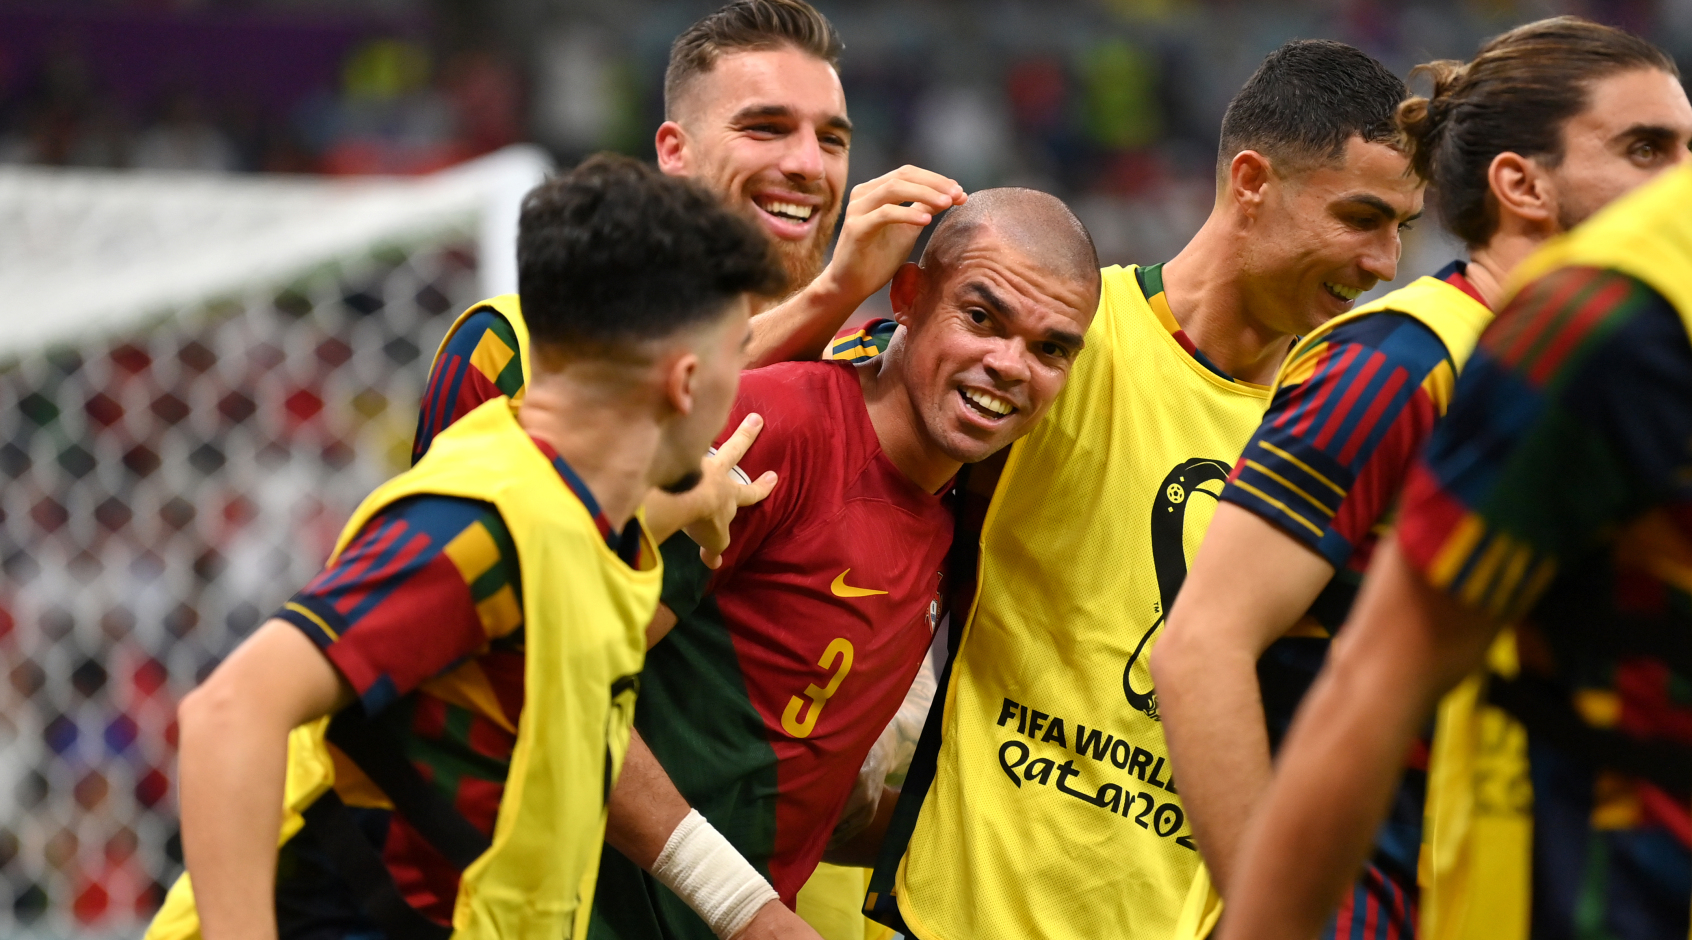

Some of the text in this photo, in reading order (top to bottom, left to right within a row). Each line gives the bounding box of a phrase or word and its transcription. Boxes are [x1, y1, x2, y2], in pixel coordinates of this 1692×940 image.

[1153, 601, 1160, 613] TM
[781, 637, 854, 738] 3
[997, 697, 1067, 748] FIFA
